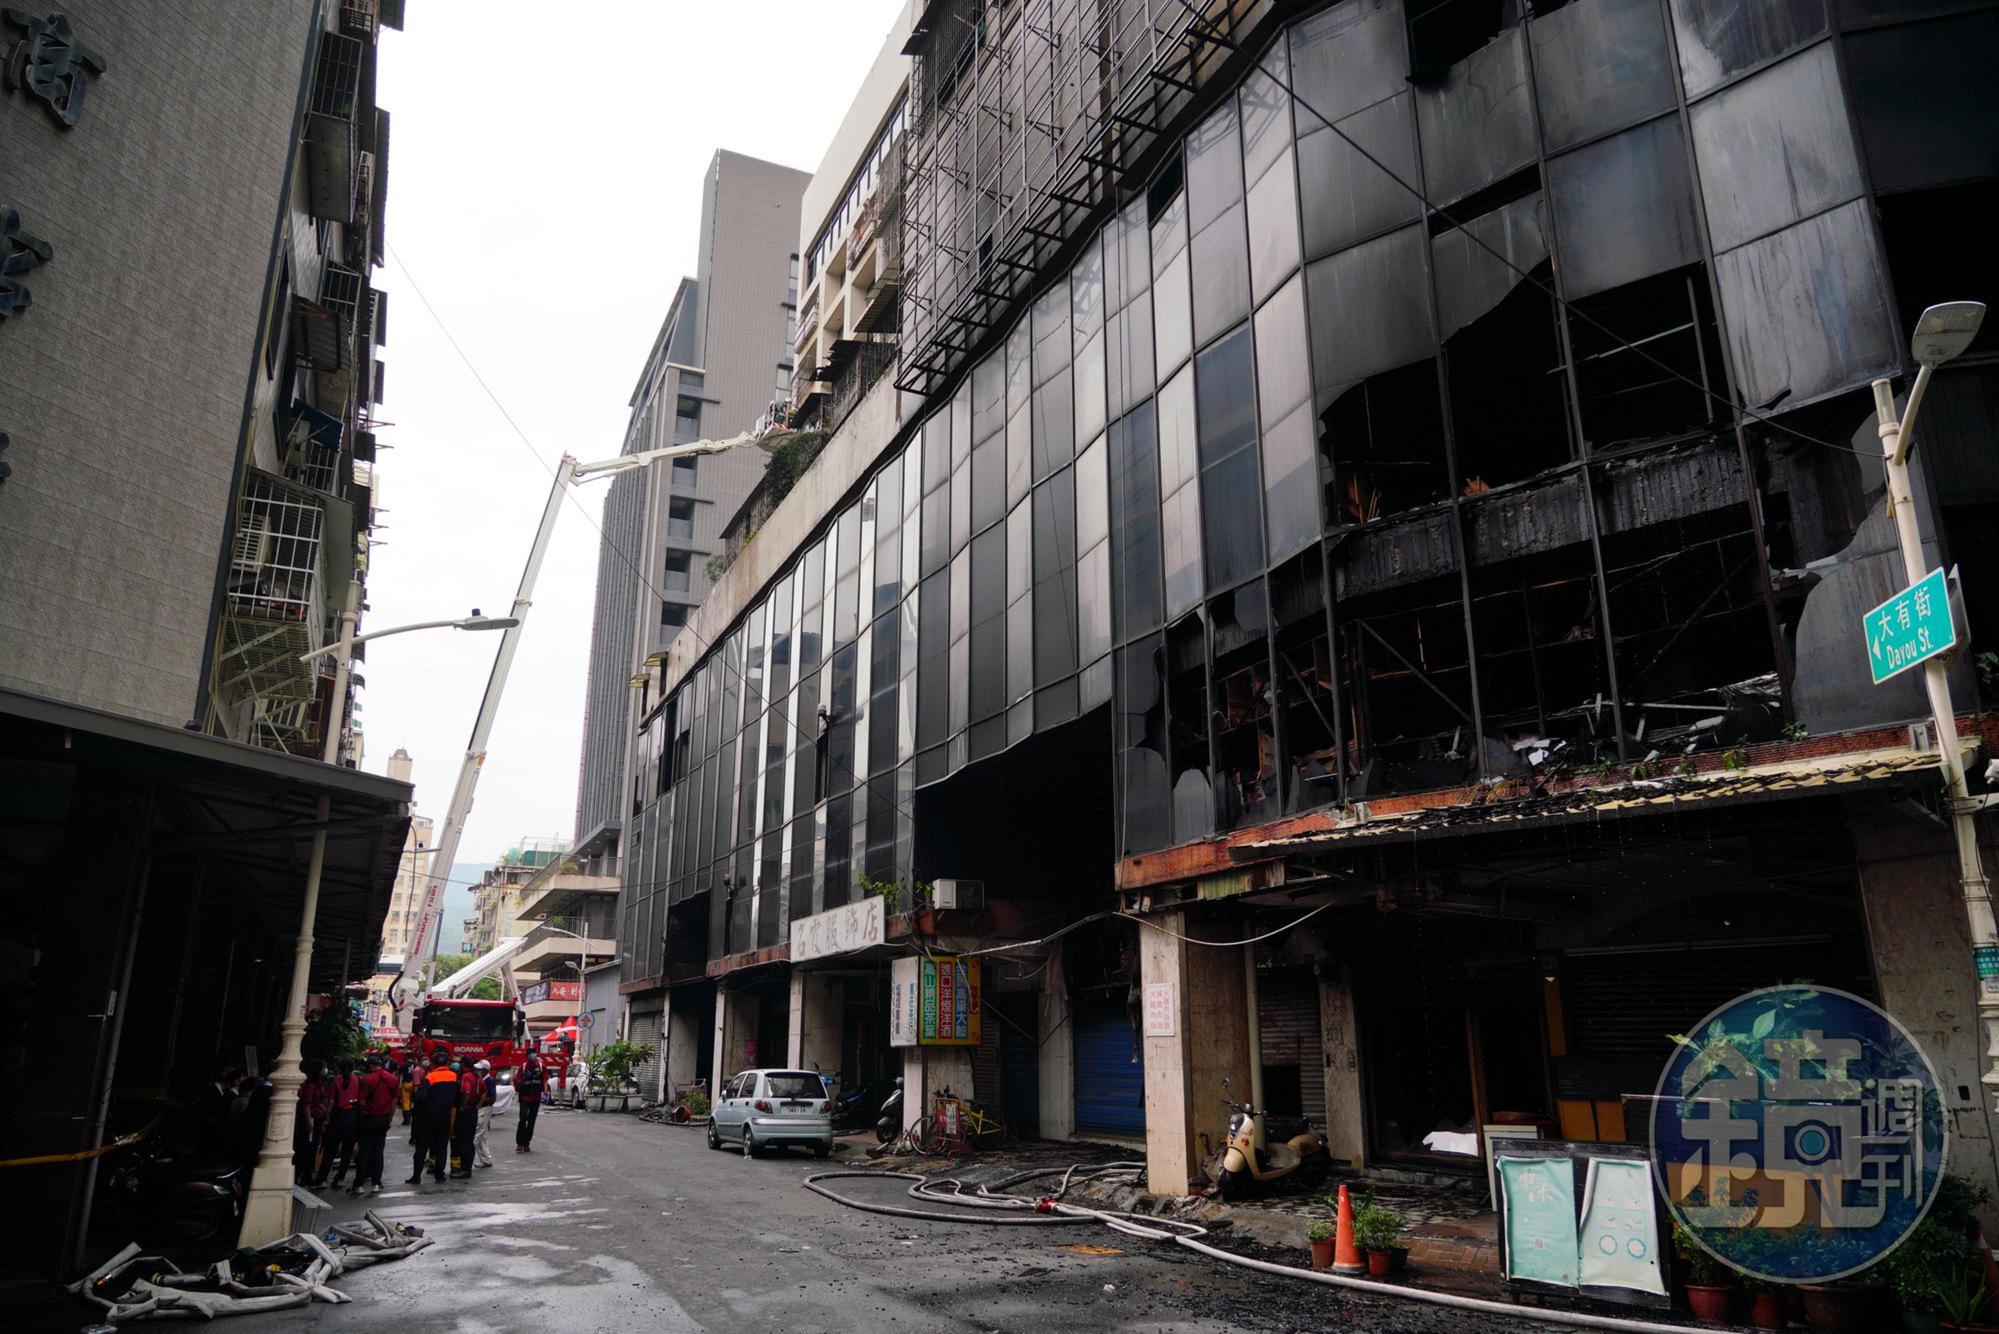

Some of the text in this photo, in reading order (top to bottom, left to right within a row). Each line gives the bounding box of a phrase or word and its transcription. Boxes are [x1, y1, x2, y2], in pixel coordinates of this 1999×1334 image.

[1878, 586, 1931, 642] 大有街
[1886, 625, 1934, 669] Dayou St.
